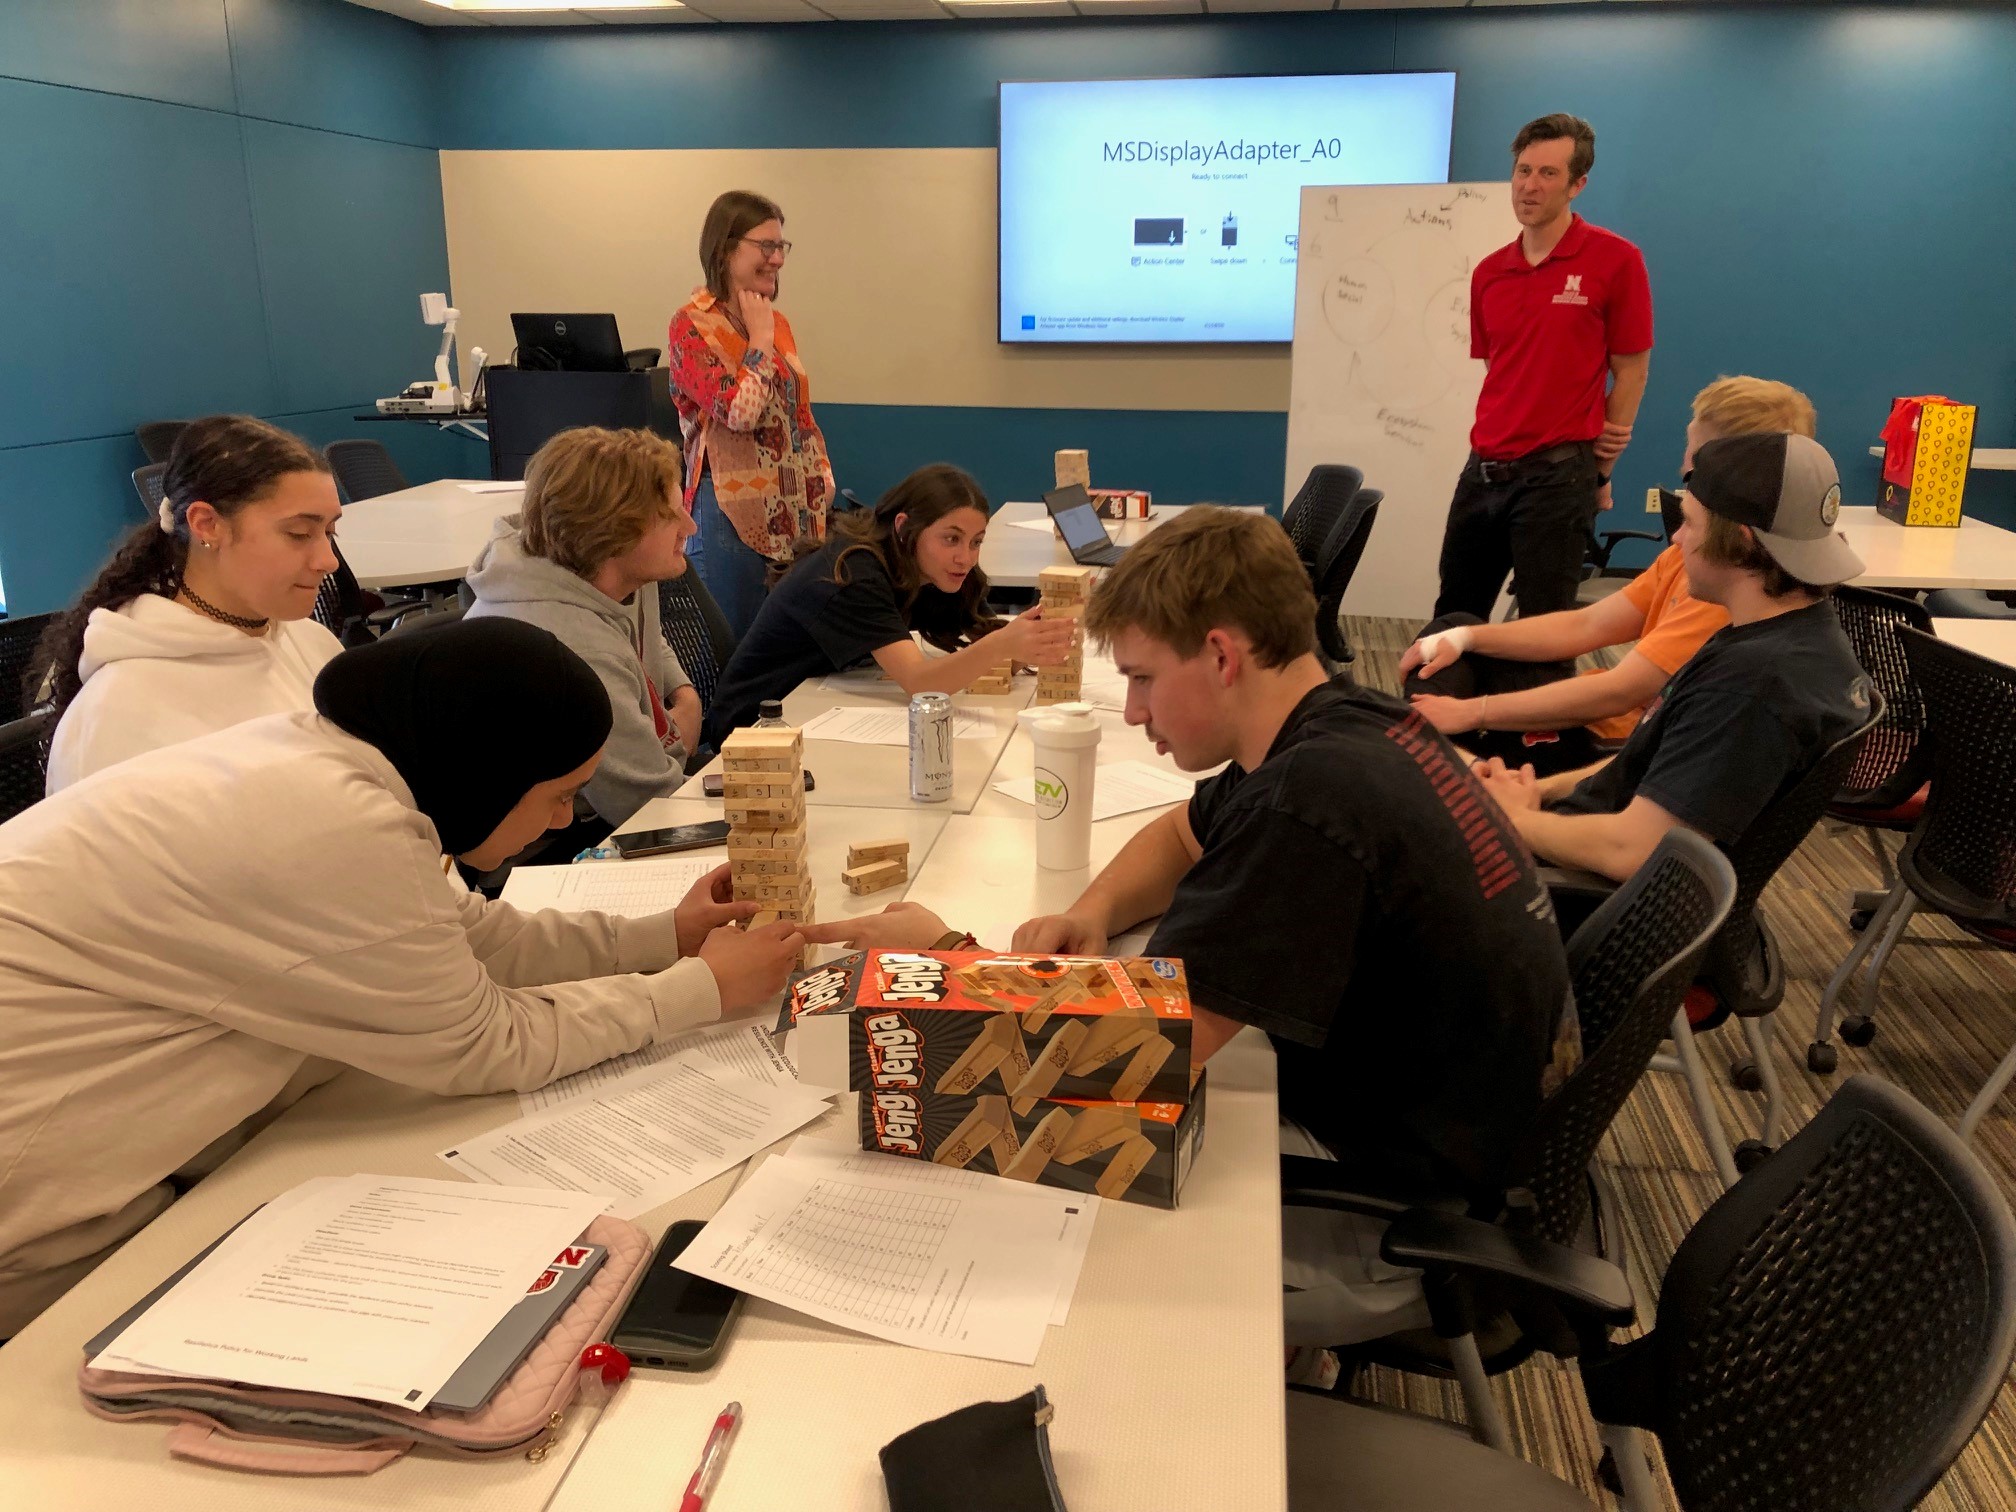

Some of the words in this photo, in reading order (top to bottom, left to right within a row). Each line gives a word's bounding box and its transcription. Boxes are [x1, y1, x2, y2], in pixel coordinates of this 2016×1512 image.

[1103, 138, 1342, 166] MSDisplayAdapter_A0
[1191, 172, 1211, 181] Ready
[1221, 172, 1248, 181] connect
[867, 1045, 879, 1072] Classic
[868, 1014, 919, 1086] Jenga
[872, 1106, 883, 1133] Classic
[875, 1090, 919, 1151] Jeng
